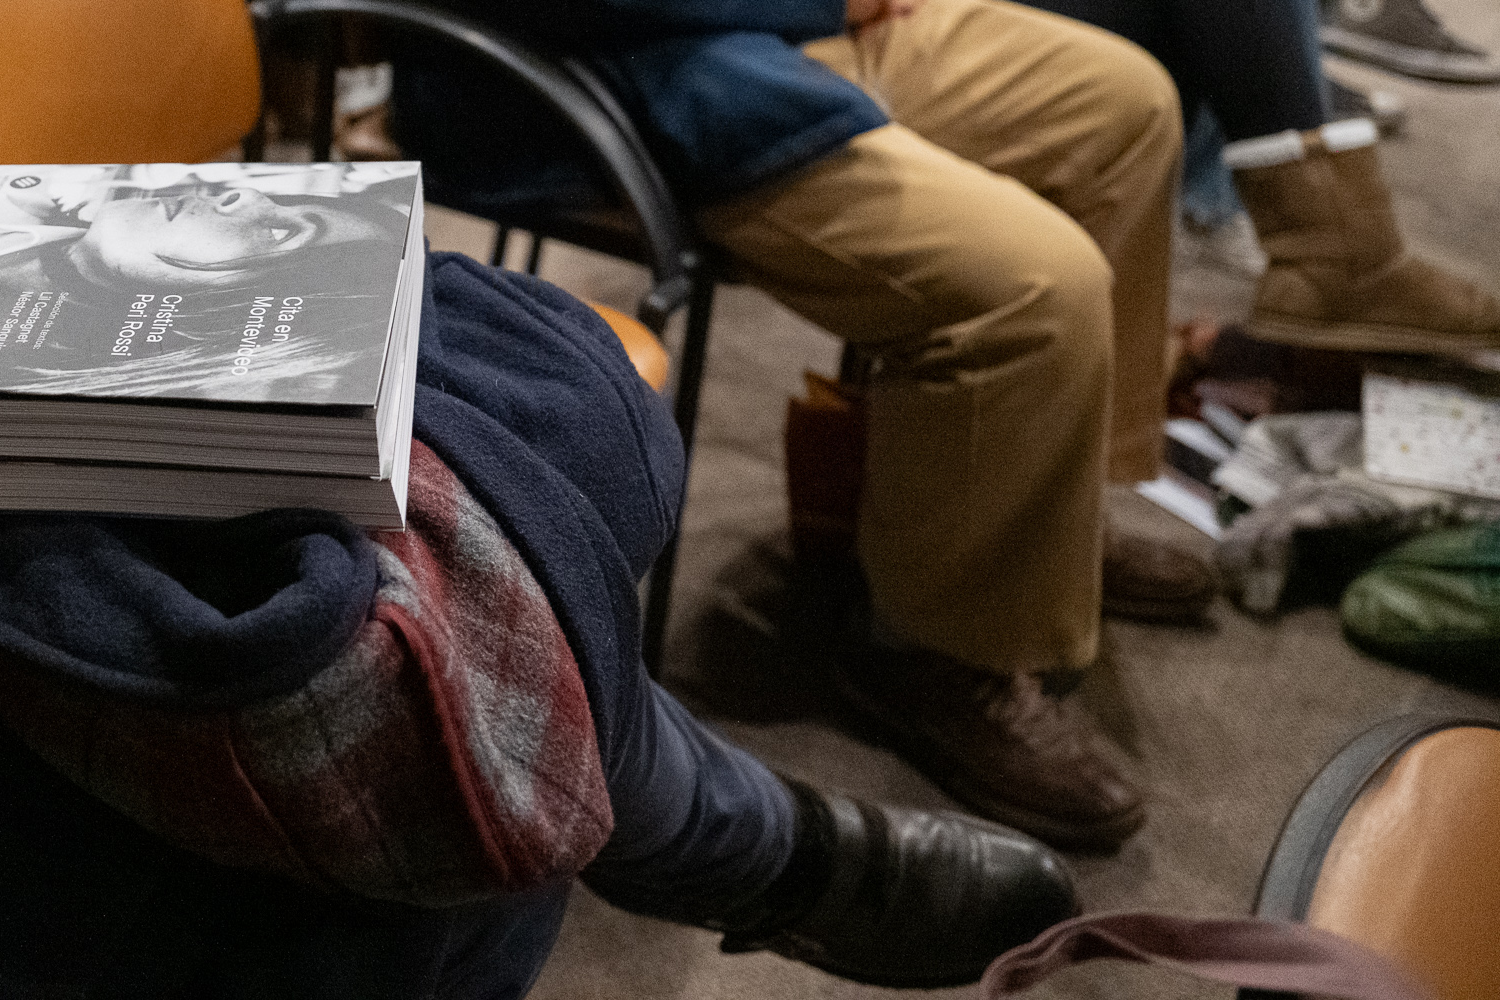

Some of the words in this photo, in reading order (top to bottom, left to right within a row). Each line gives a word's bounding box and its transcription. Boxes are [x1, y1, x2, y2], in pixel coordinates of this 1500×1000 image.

[10, 291, 34, 317] Néstor
[38, 291, 53, 301] Lil
[48, 291, 70, 319] Selección
[127, 294, 155, 318] Peri
[277, 296, 303, 322] Cita
[15, 301, 47, 344] Castagnet
[43, 320, 55, 328] de
[146, 294, 183, 343] Cristina
[33, 329, 51, 350] textos:
[110, 321, 143, 357] Rossi
[231, 296, 275, 376] Montevideo
[271, 325, 292, 342] en
